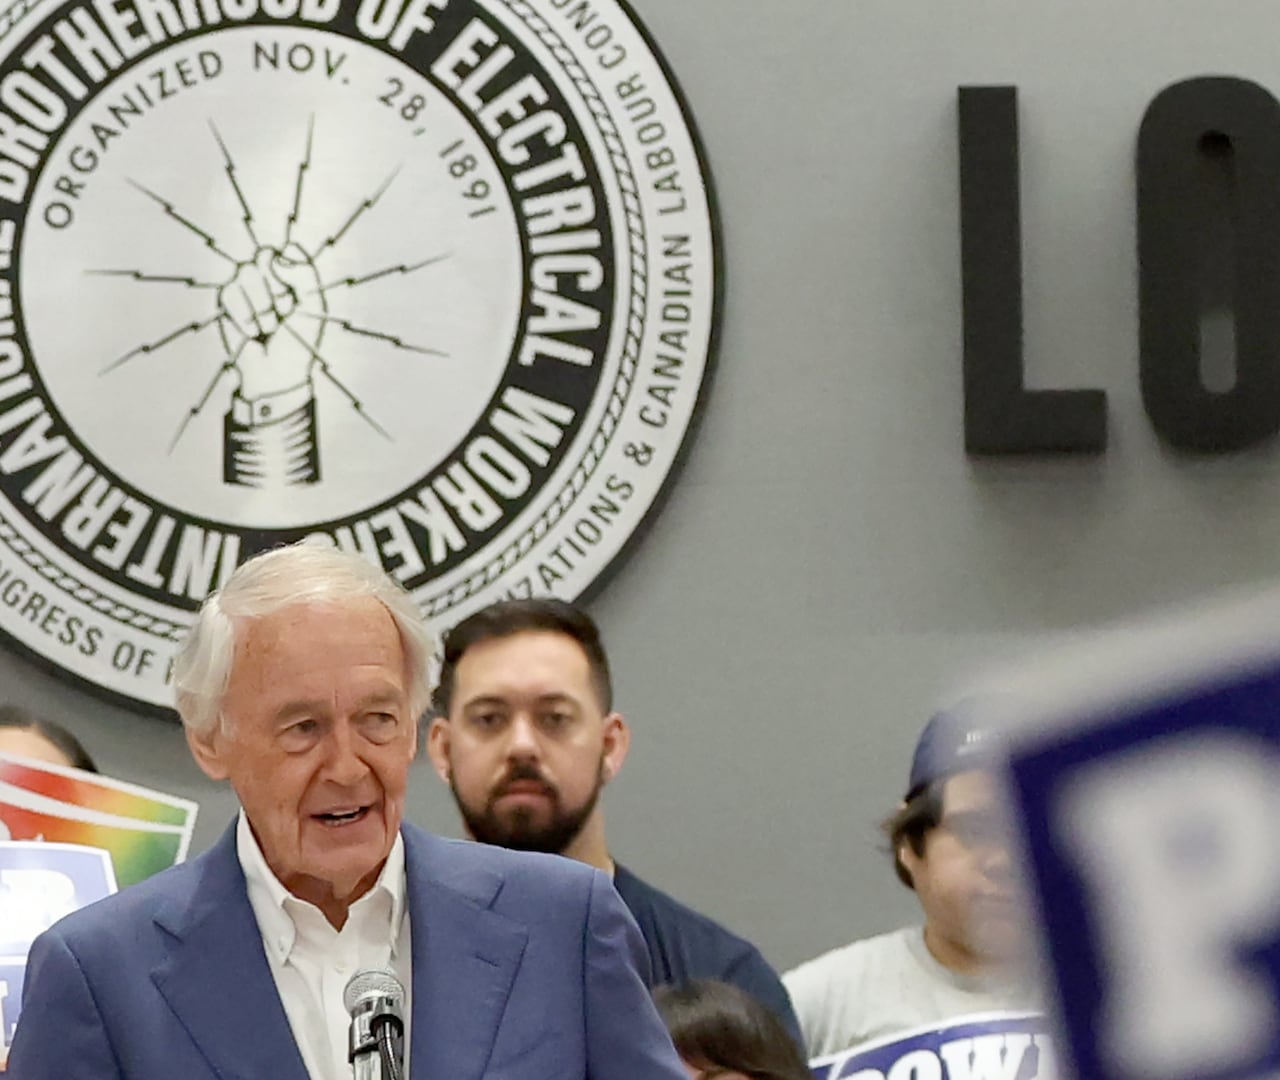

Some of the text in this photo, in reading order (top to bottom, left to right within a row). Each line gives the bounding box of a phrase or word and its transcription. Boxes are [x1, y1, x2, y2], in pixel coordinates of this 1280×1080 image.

[43, 41, 497, 229] ORGANIZED NOV. 28, 1891
[430, 17, 604, 368] ELECTRICAL
[616, 71, 687, 215] LABOUR
[640, 233, 693, 429] CANADIAN
[323, 386, 576, 584] WORKER
[624, 442, 655, 467] &
[112, 641, 158, 680] OF
